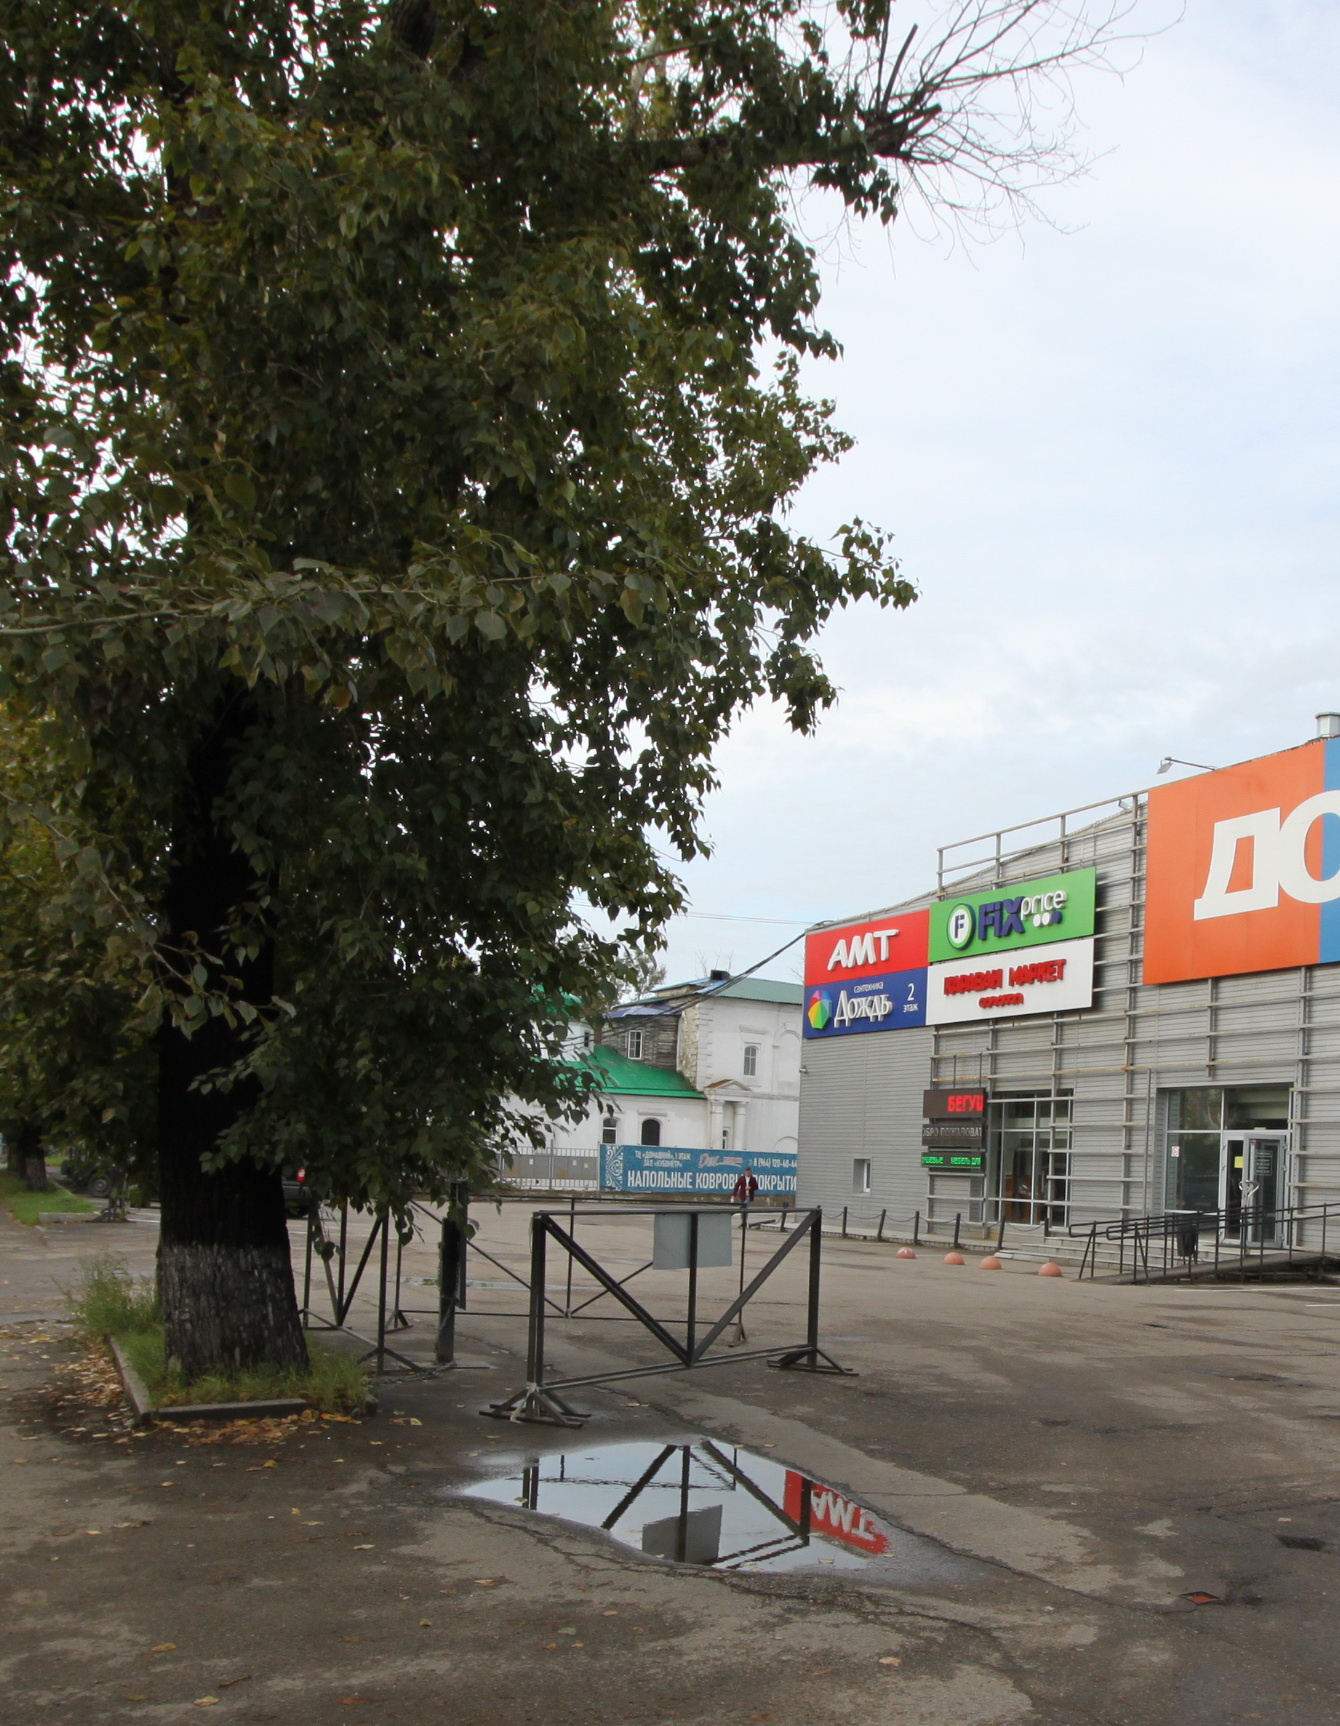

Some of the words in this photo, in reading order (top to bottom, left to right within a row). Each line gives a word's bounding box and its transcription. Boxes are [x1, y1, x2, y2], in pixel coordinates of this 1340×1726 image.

[1021, 890, 1068, 921] price
[1009, 959, 1066, 988] МАРКЕТ
[854, 981, 884, 993] сантехника
[907, 983, 915, 1001] 2
[903, 1003, 918, 1013] этаж
[627, 1170, 693, 1188] НАПОЛЬНЫЕ
[695, 1172, 744, 1189] КОВРОВ
